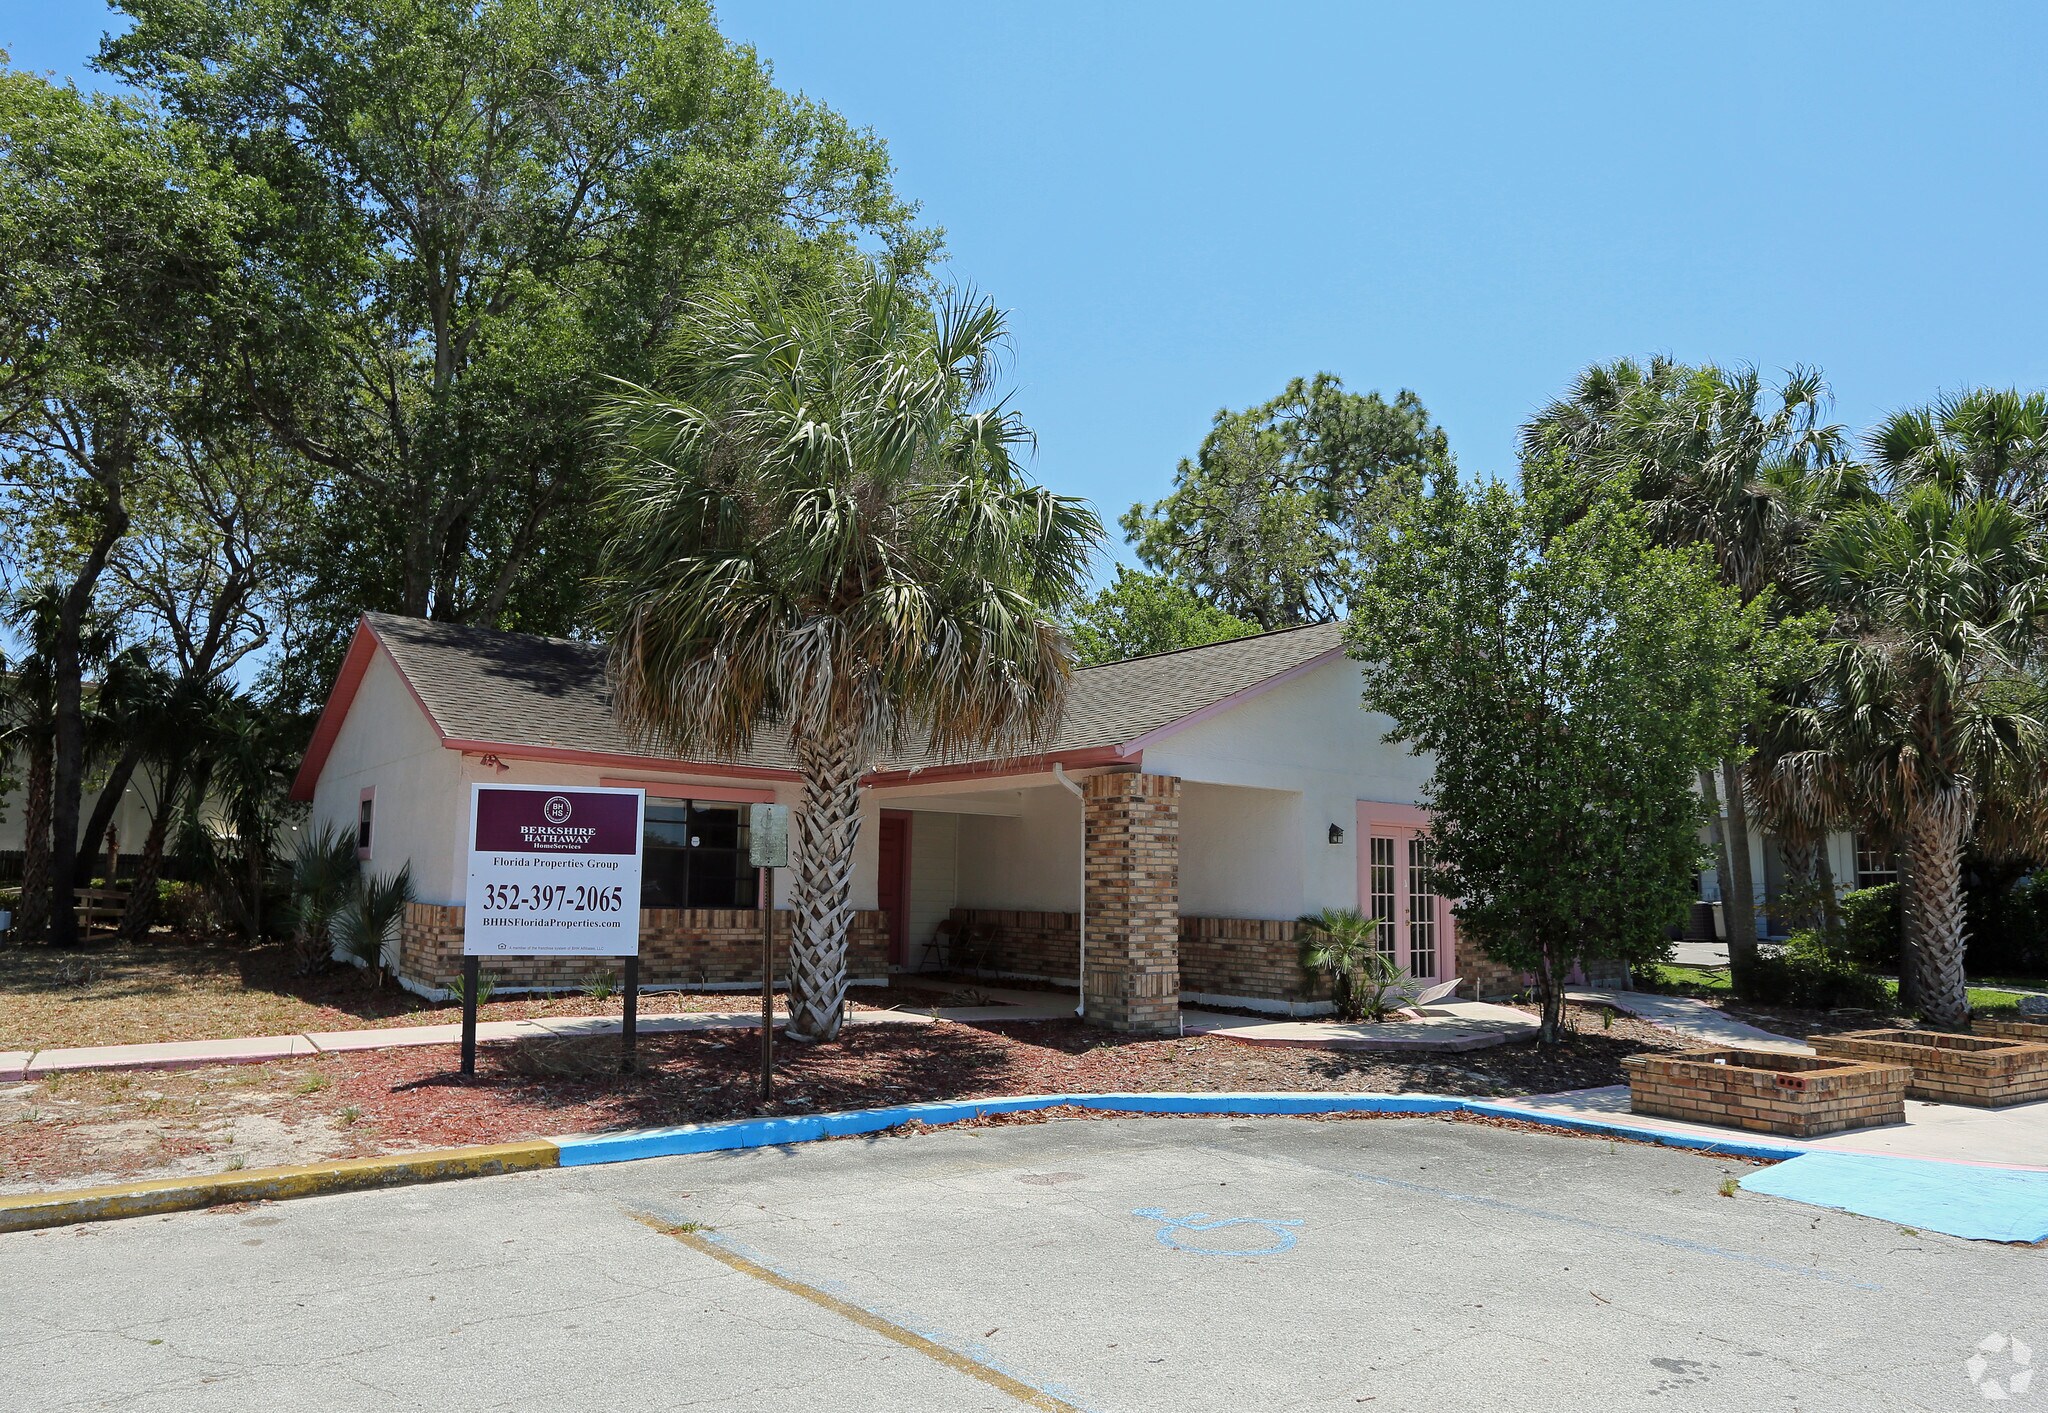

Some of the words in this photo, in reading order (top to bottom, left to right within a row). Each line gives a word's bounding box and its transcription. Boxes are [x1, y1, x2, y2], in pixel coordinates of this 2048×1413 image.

[520, 826, 596, 836] BERKSHIRE
[524, 834, 591, 844] HATHAWAY
[493, 857, 530, 866] Florida
[534, 858, 584, 870] Properties
[587, 860, 619, 870] Group
[483, 884, 622, 912] 352-397-2065
[483, 918, 621, 928] BHHSFloridaProperties.com
